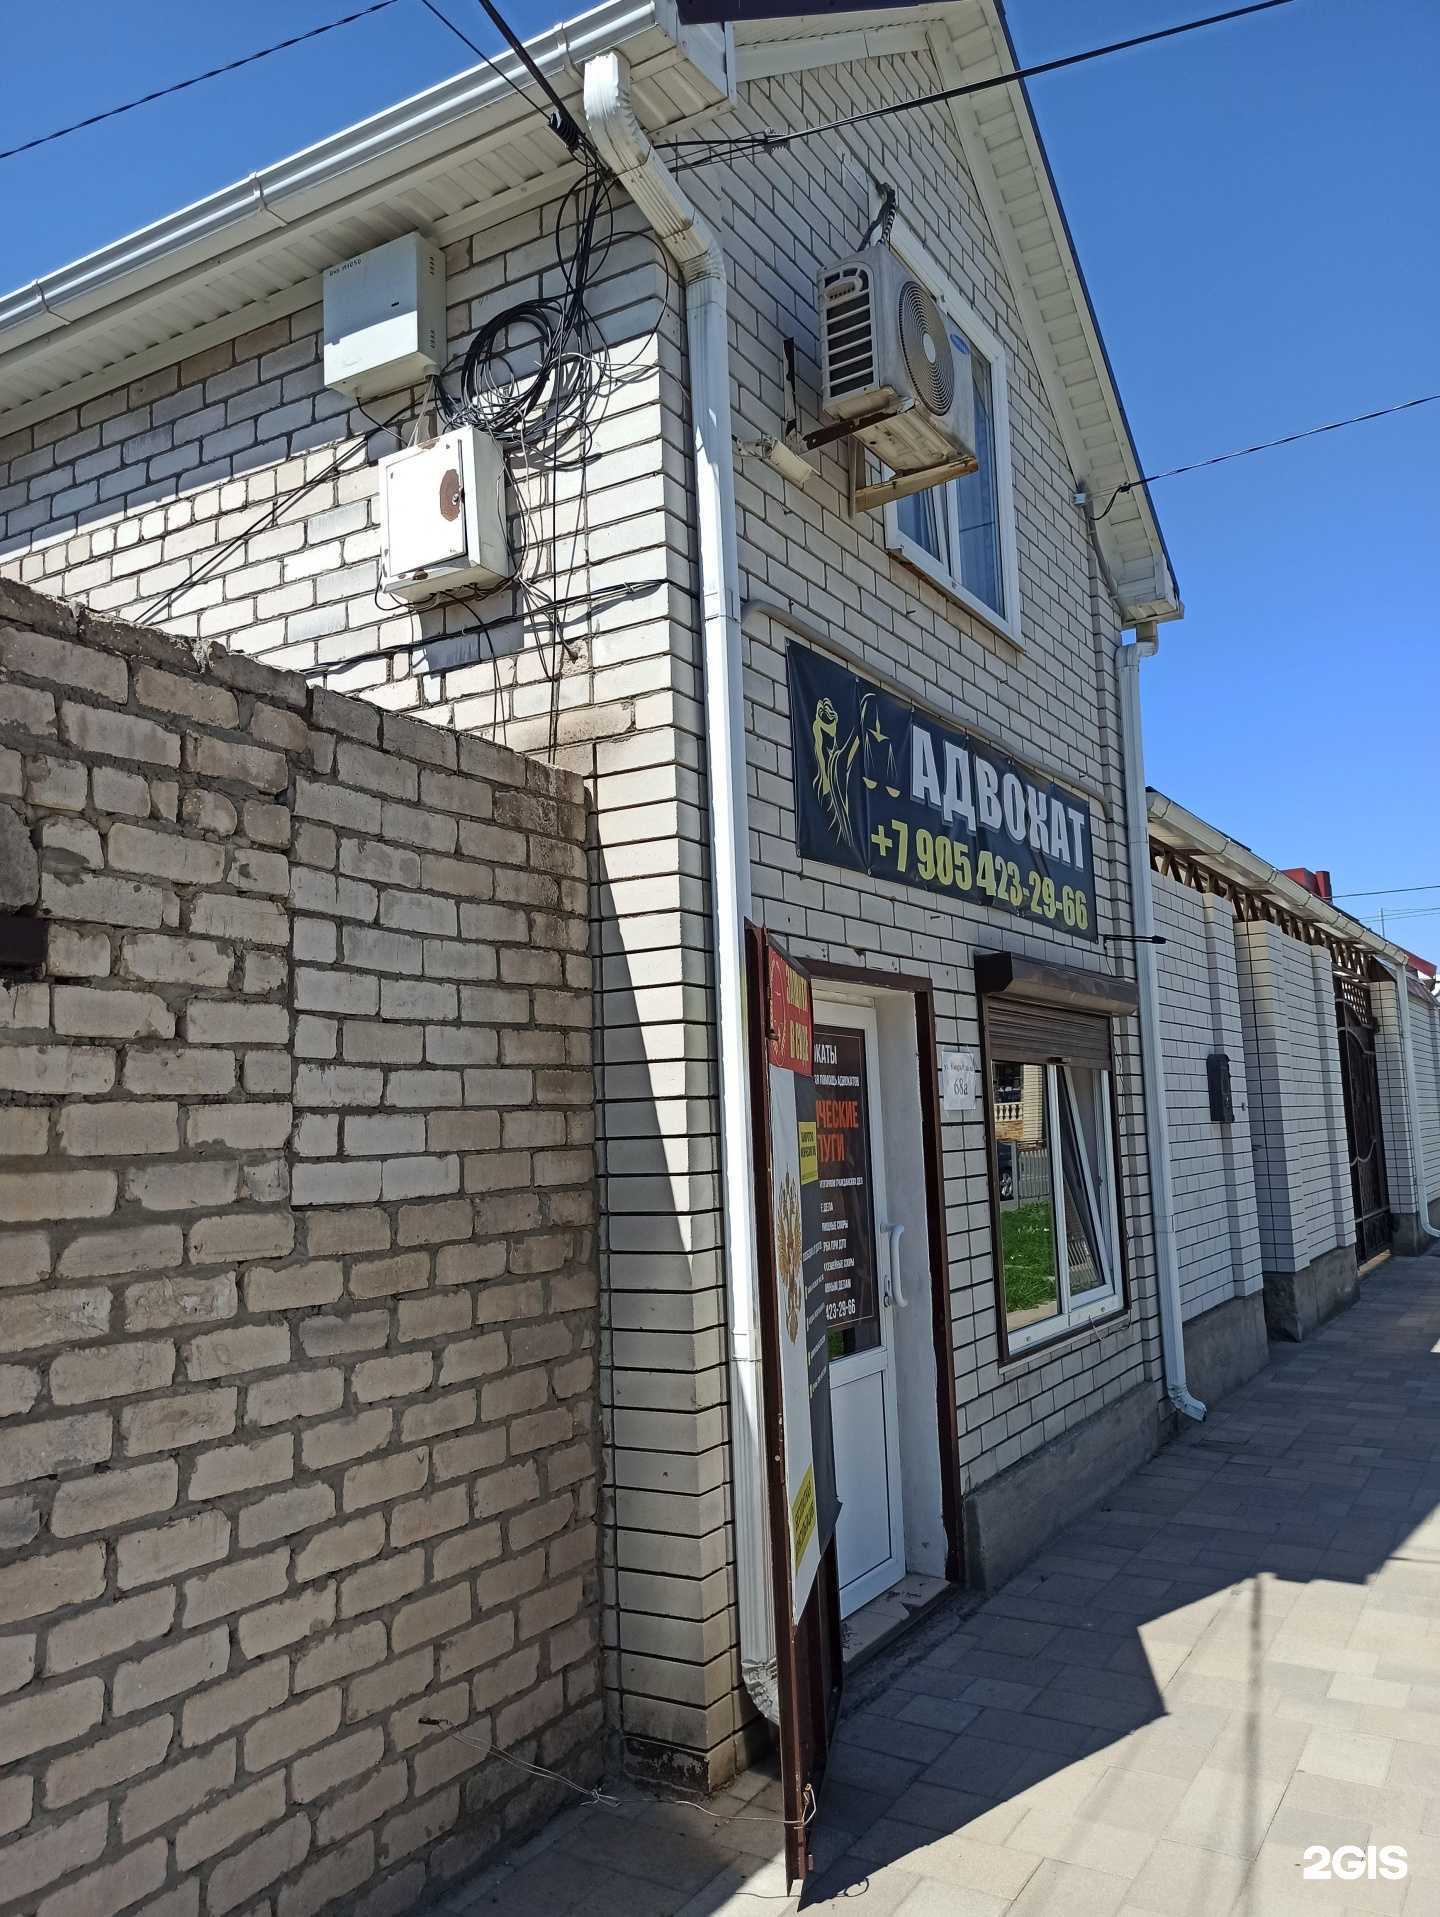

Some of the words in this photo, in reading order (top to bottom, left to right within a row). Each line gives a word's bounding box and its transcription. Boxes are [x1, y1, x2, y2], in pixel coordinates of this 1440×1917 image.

[911, 723, 1086, 871] АДВОКАТ
[871, 819, 910, 873] +7
[915, 828, 973, 892] 905
[976, 849, 1089, 931] 423-29-66
